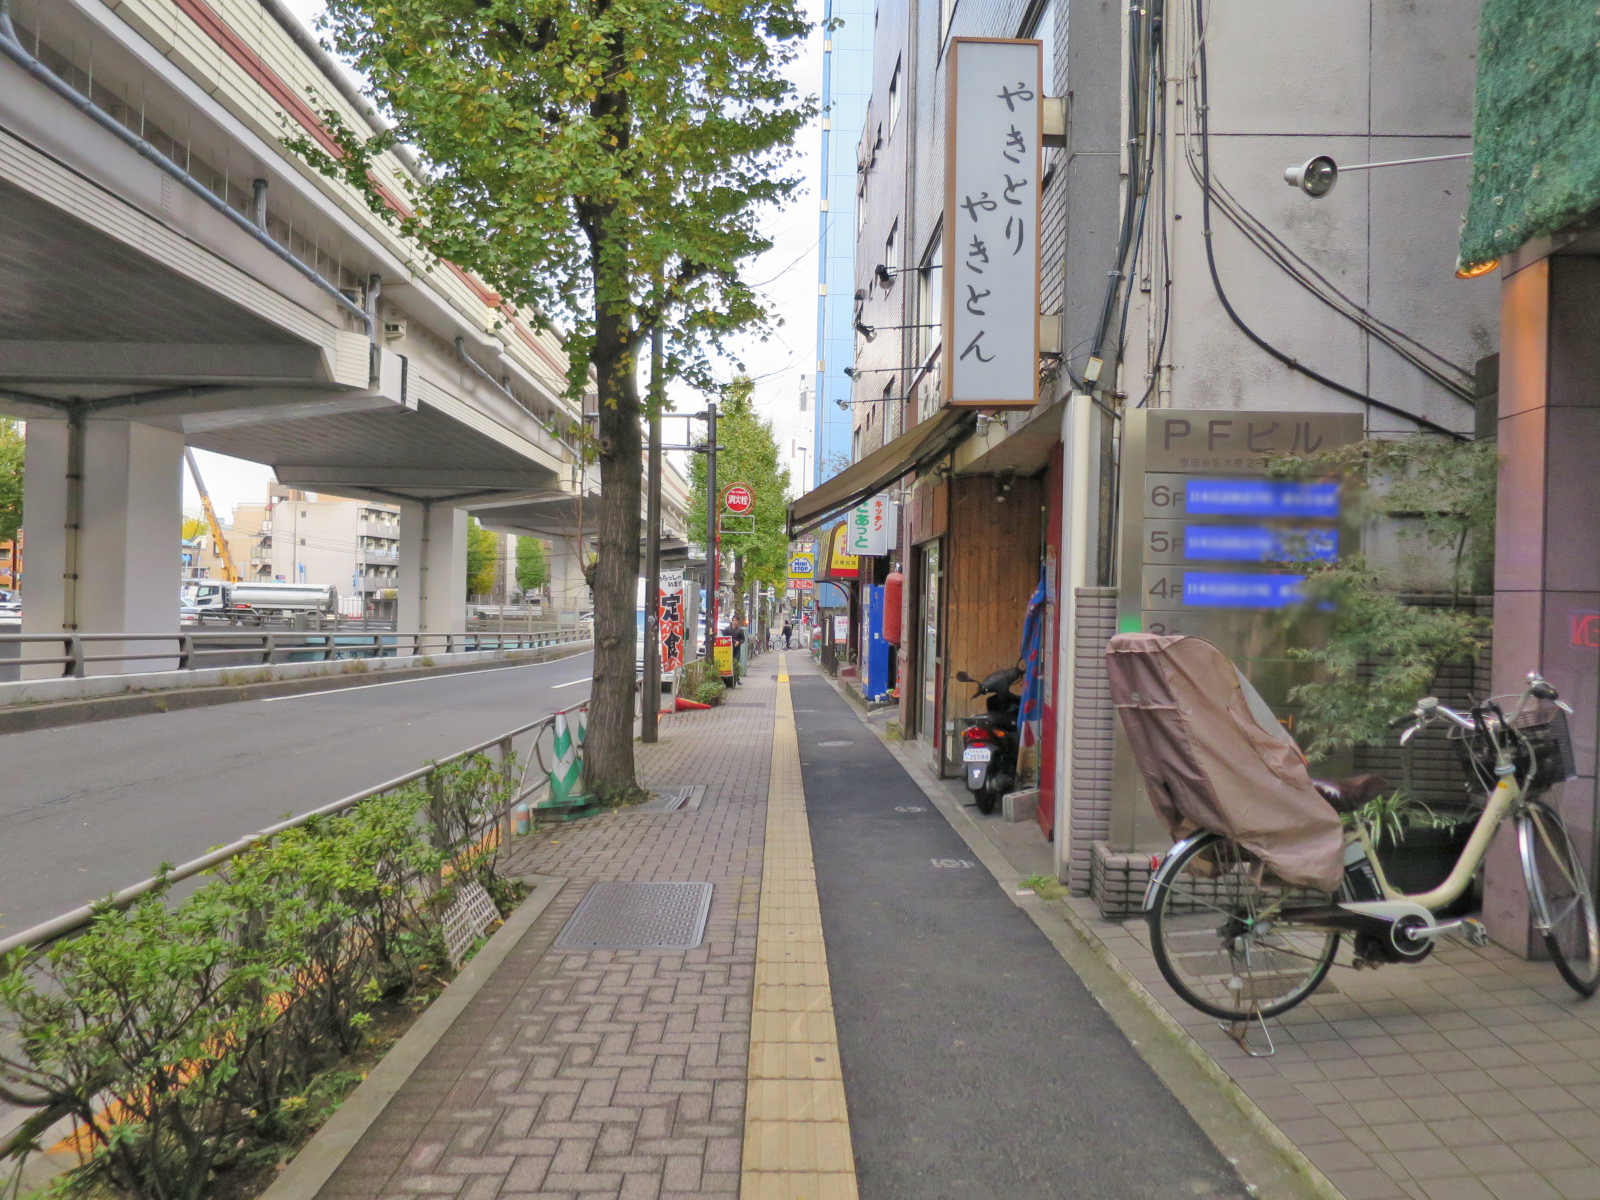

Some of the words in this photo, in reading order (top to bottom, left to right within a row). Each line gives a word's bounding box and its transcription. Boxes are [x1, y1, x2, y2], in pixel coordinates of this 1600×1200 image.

[997, 82, 1034, 256] やきとり
[960, 191, 997, 362] やきとん
[728, 494, 748, 505] 消火栓
[1151, 485, 1184, 507] 6F
[874, 500, 883, 531] キッチン
[1150, 531, 1182, 552] 5F
[1149, 577, 1182, 599] 4F
[661, 594, 681, 660] 定食
